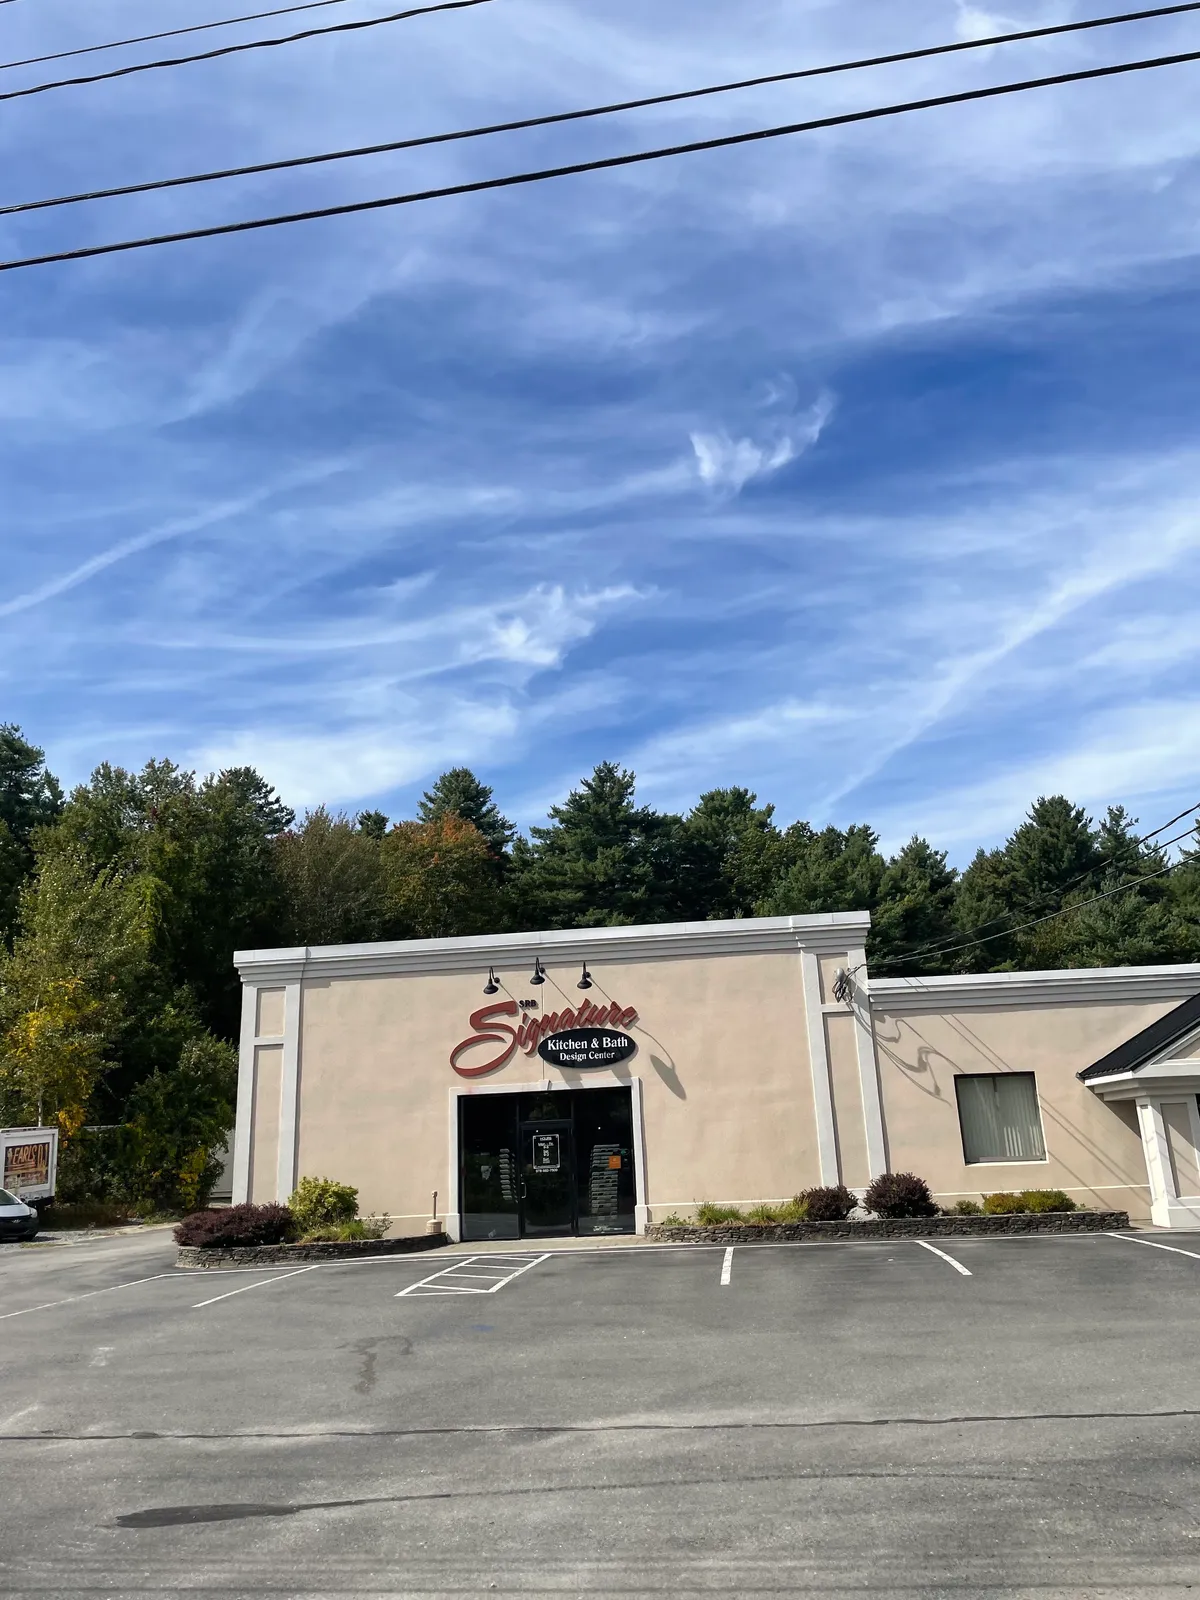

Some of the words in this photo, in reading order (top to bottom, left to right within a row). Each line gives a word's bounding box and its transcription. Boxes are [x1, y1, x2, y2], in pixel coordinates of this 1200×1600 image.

[519, 999, 537, 1008] SRB
[450, 998, 637, 1077] Signature
[547, 1039, 588, 1051] Kitchen
[591, 1037, 600, 1049] &
[603, 1036, 628, 1048] Bath
[559, 1052, 587, 1062] Design
[589, 1050, 615, 1060] Center
